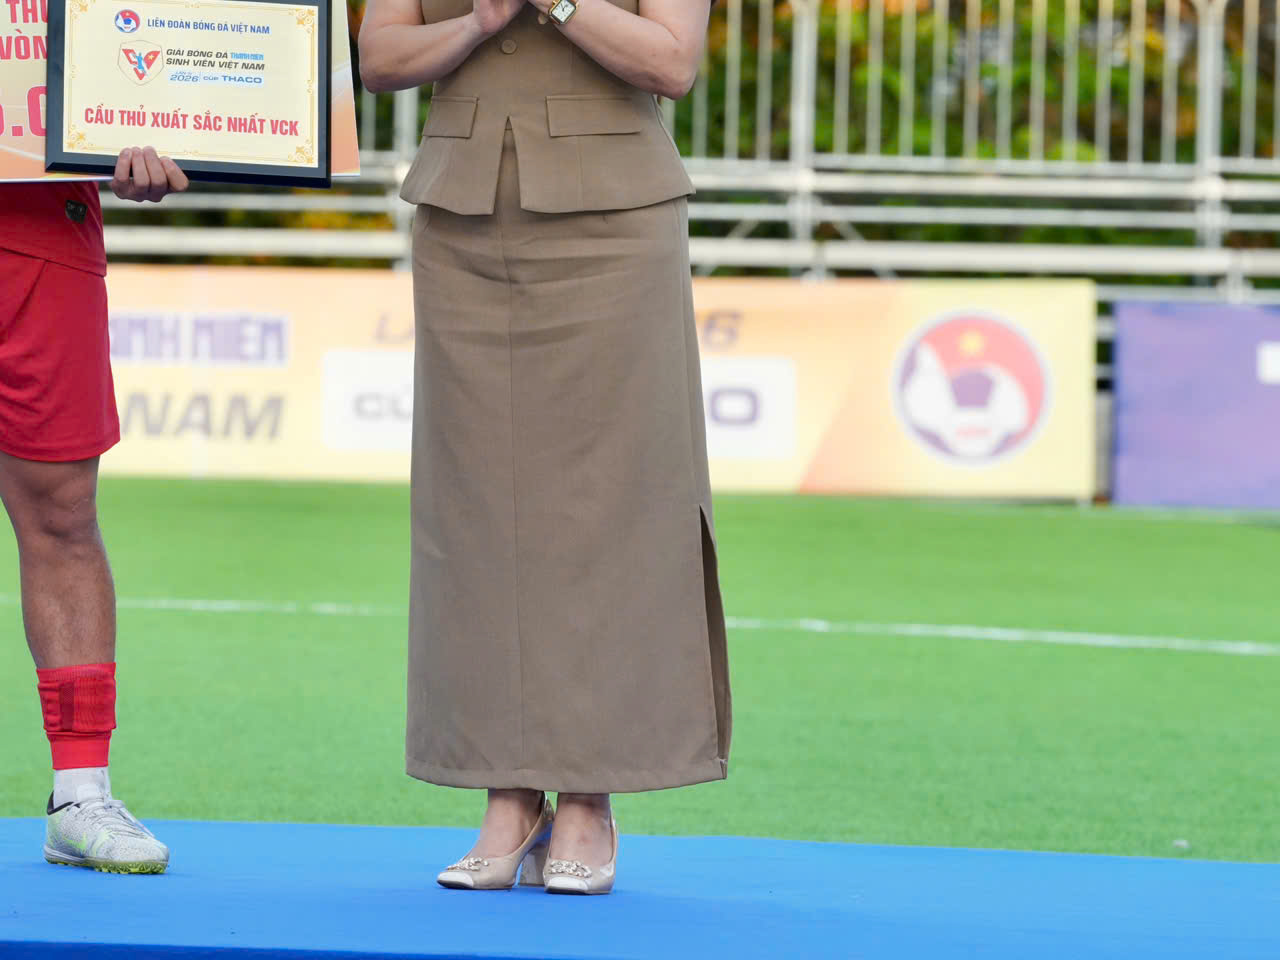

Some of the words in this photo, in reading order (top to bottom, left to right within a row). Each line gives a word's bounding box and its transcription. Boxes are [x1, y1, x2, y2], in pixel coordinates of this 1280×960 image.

[250, 24, 270, 34] NAM
[166, 57, 190, 66] SINH
[241, 62, 265, 71] NAM
[221, 74, 263, 84] THACO
[118, 104, 146, 127] THỦ
[150, 108, 189, 130] XUẤT
[193, 110, 223, 132] SẮC
[227, 112, 266, 135] NHẤT
[269, 119, 299, 137] VCK
[121, 392, 286, 441] NAM
